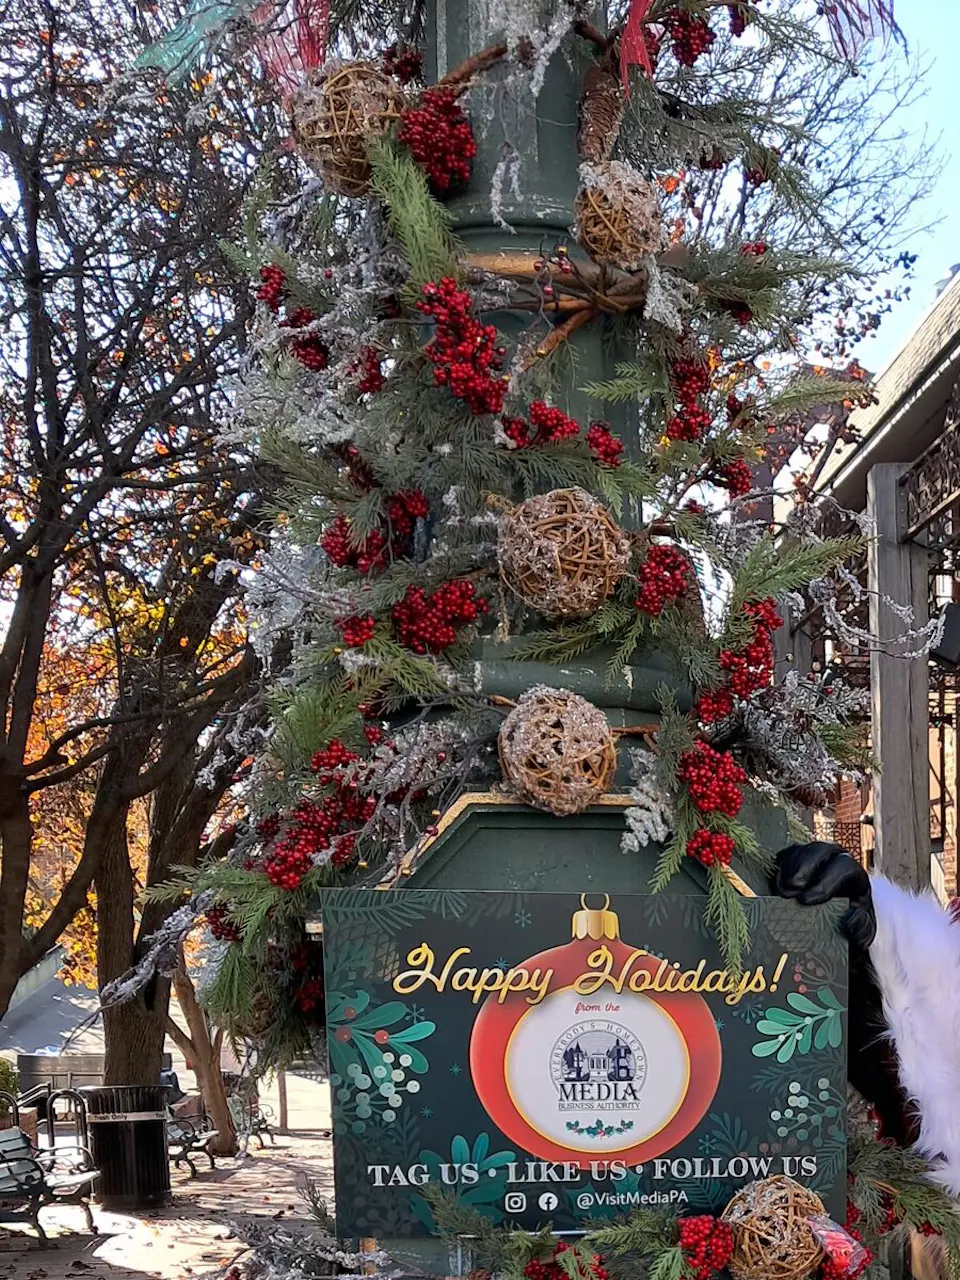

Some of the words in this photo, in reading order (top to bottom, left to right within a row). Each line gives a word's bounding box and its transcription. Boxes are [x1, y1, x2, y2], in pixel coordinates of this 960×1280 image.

[393, 942, 554, 1005] Happy
[573, 944, 789, 1006] Holidays!
[575, 1003, 600, 1014] from
[605, 1003, 621, 1011] the
[606, 1023, 645, 1081] HOMETOWN
[558, 1083, 641, 1102] MEDIA
[367, 1163, 431, 1187] TAG
[438, 1163, 480, 1185] US
[506, 1161, 581, 1183] LIKE
[586, 1159, 627, 1181] US
[652, 1156, 774, 1180] FOLLOW
[781, 1155, 818, 1177] US
[577, 1190, 689, 1210] @VisitMediaPA
